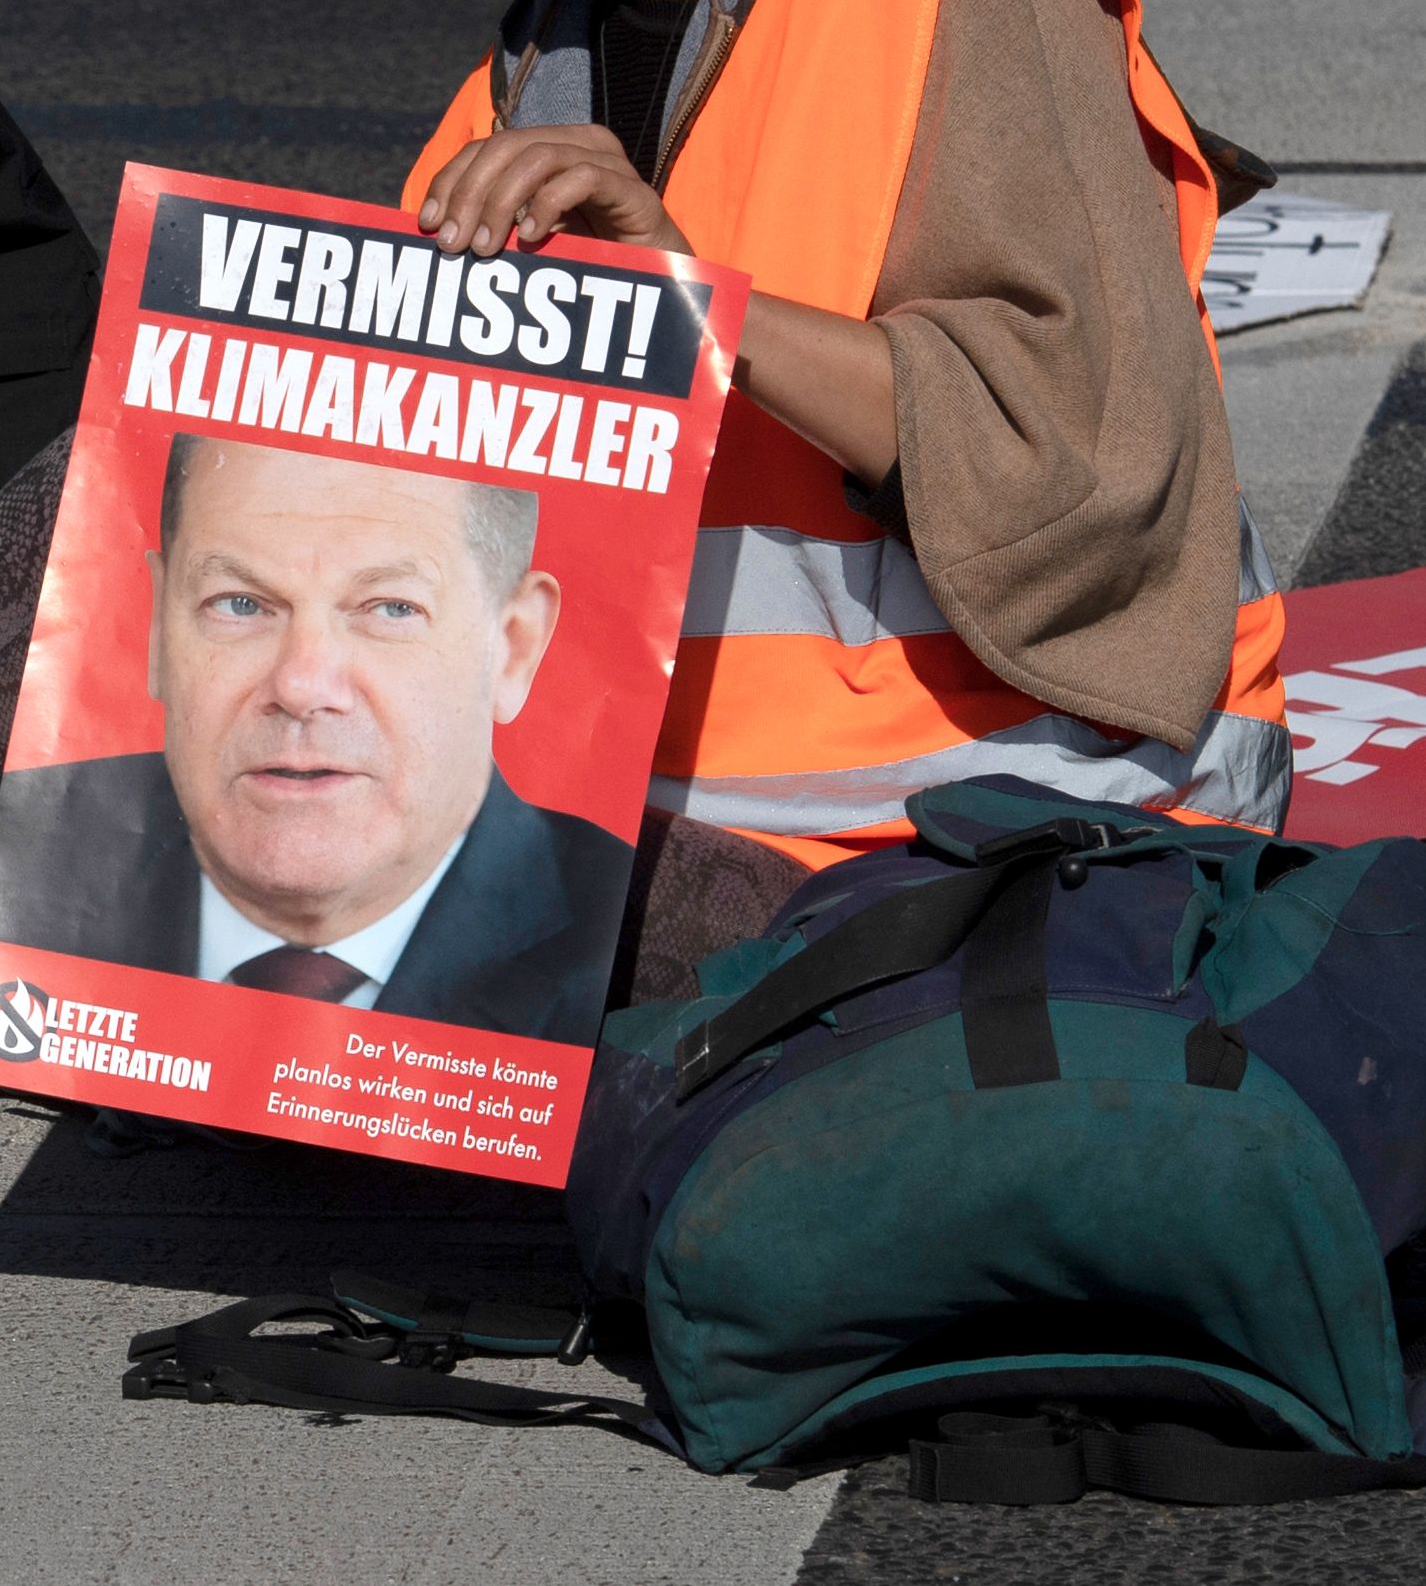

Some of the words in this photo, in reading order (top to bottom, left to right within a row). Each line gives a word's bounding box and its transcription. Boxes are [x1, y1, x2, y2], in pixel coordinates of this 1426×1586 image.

[199, 212, 662, 380] VERMISST!
[123, 323, 680, 495] KLIMAKANZLER
[45, 997, 139, 1043] LETZTE
[39, 1032, 212, 1092] GENERATION
[273, 1057, 352, 1090] planlos
[358, 1076, 427, 1104] wirken
[433, 1089, 473, 1112] und
[476, 1096, 514, 1119] sich
[519, 1104, 554, 1126] auf
[345, 1033, 386, 1059] Der
[391, 1041, 487, 1078] Vermisste
[492, 1058, 558, 1090] könnte
[266, 1091, 457, 1147] Erinnerungslücken
[462, 1126, 543, 1161] berufen.
